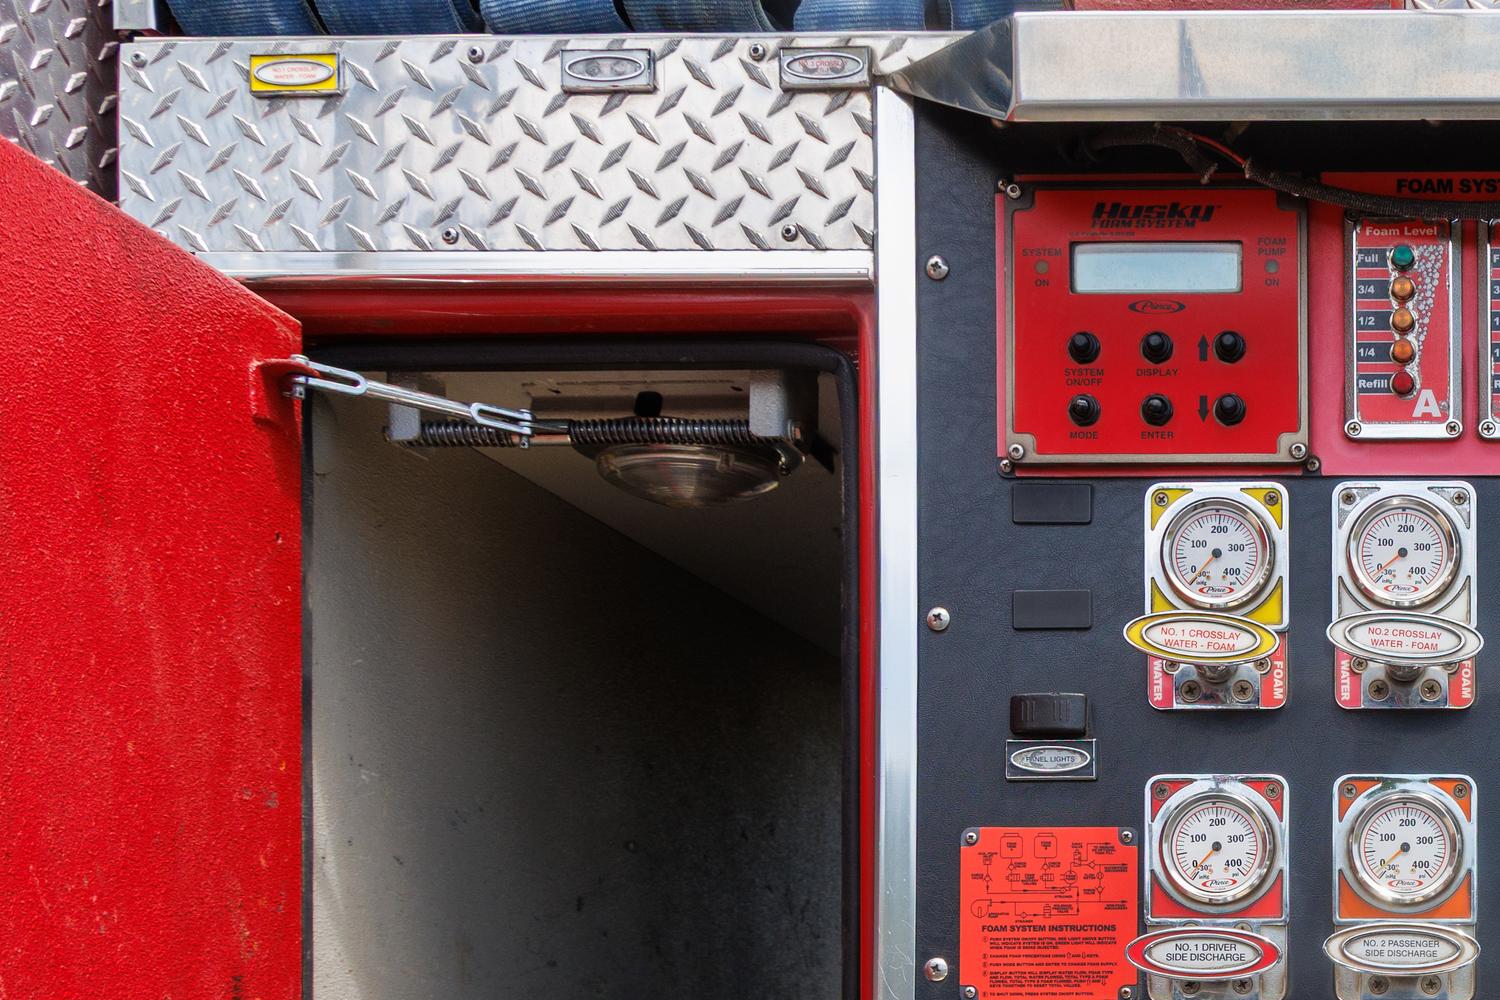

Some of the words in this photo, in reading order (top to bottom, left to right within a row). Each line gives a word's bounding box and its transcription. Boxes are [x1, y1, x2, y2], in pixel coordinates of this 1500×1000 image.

[1396, 179, 1454, 193] FOAM
[1093, 202, 1215, 222] Husky
[1365, 226, 1400, 236] Foam
[1404, 226, 1437, 236] Level
[1257, 236, 1288, 246] FOAM
[1022, 248, 1062, 257] SYSTEM
[1257, 247, 1288, 257] PUMP
[1357, 253, 1379, 263] Full
[1357, 284, 1376, 295] 3/4
[1358, 316, 1376, 327] 1/2
[1358, 347, 1377, 358] 1/4
[1064, 368, 1105, 377] SYSTEM
[1136, 368, 1178, 377] DISPLAY
[1066, 378, 1104, 387] ON/OFF
[1358, 379, 1389, 389] Refill
[1412, 389, 1442, 417] A
[1069, 431, 1099, 440] MODE
[1140, 431, 1175, 440] ENTER
[1161, 627, 1178, 637] NO.
[1188, 629, 1241, 641] CROSSLAY
[1392, 629, 1442, 640] CROSSLAY
[1164, 639, 1198, 649] WATER
[1207, 641, 1236, 651] FOAM
[1370, 639, 1403, 649] WATER
[1411, 641, 1438, 651] FOAM
[981, 924, 1008, 933] FOAM
[1009, 924, 1047, 933] SYSTEM
[1048, 924, 1117, 932] INSTRUCTIONS
[1175, 943, 1192, 951] NO.
[1202, 943, 1237, 951] DRIVER
[1388, 940, 1440, 948] PASSENGER
[1166, 953, 1188, 961] SIDE
[1190, 953, 1246, 961] DISCHARGE
[1365, 949, 1385, 957] SIDE
[1387, 949, 1438, 958] DISCHARGE
